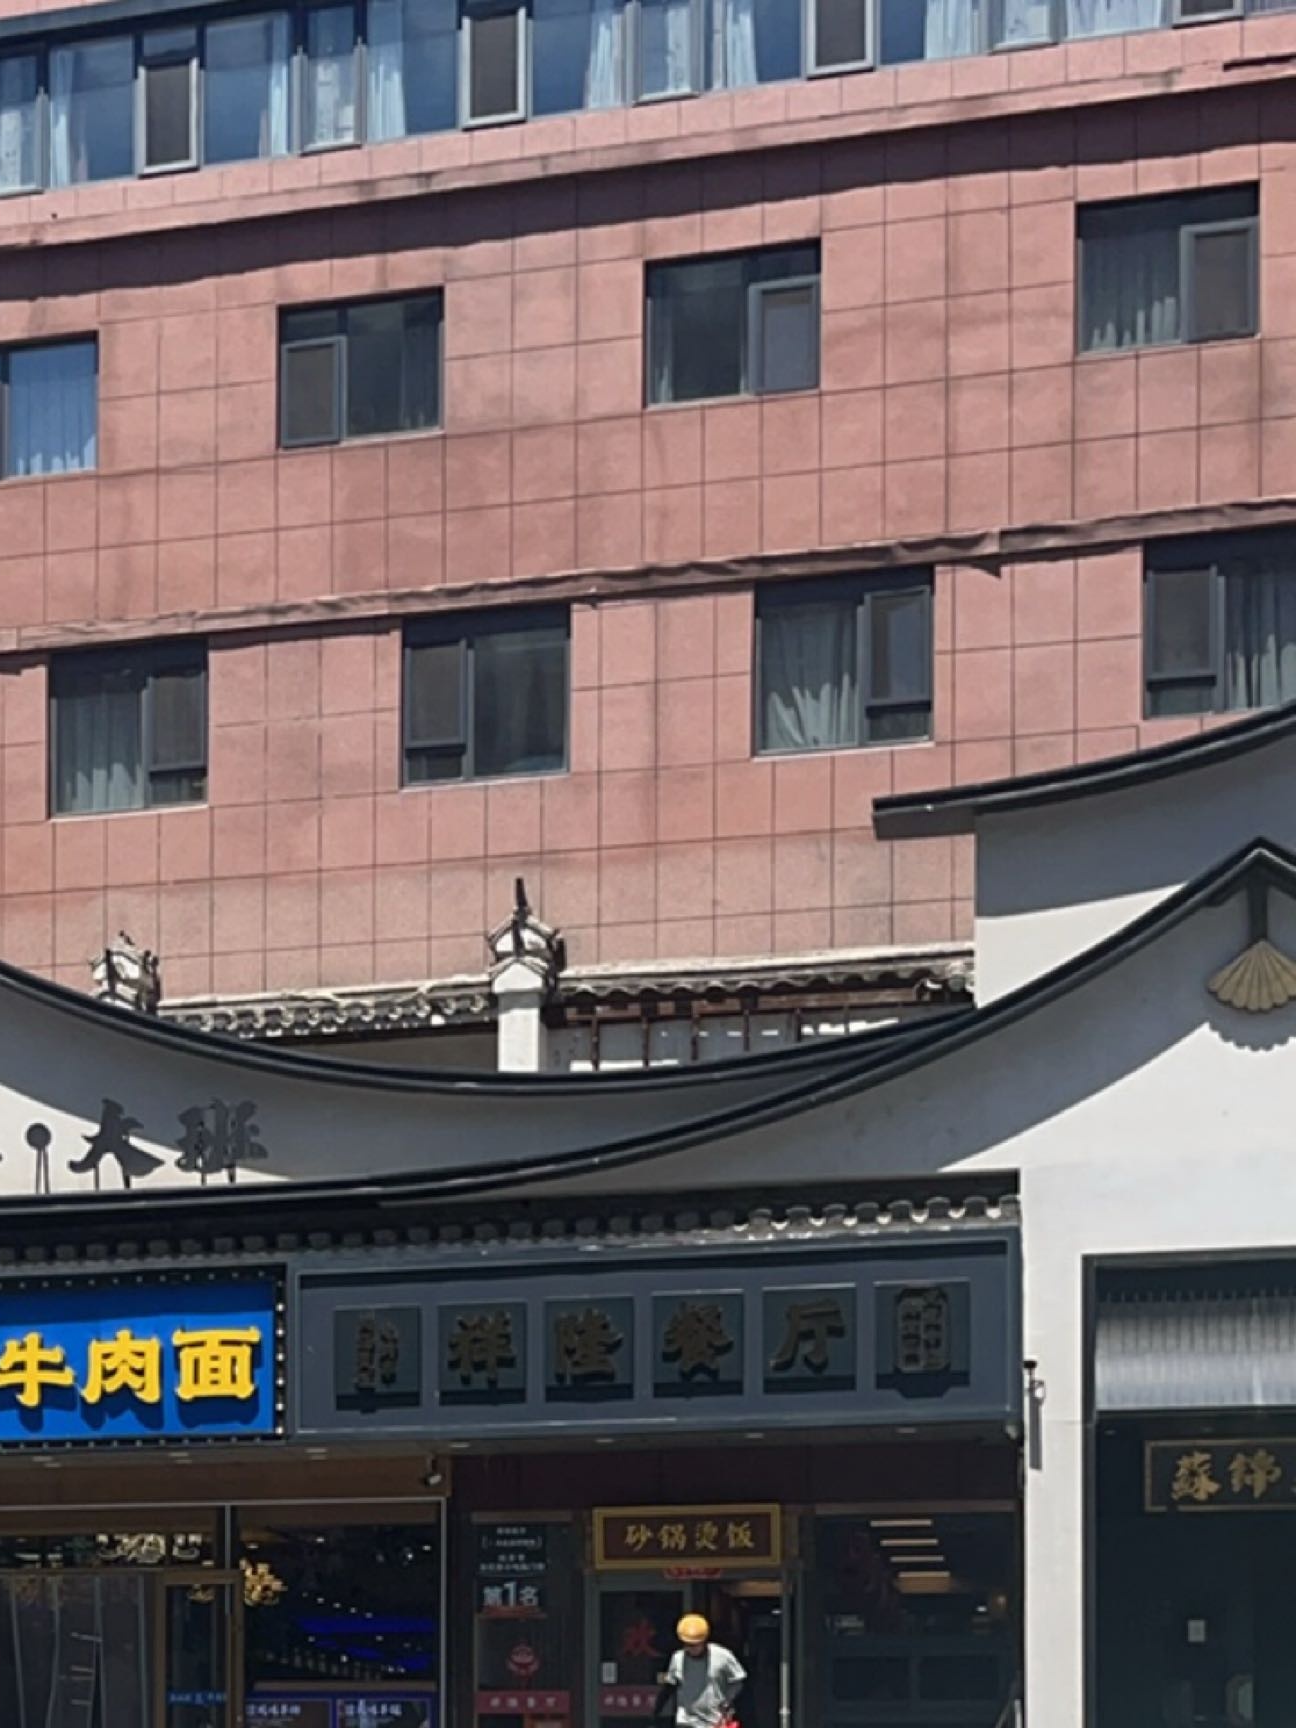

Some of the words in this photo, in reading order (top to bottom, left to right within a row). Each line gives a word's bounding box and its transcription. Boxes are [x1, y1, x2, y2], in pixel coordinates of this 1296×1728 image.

[449, 1302, 845, 1385] 祥隆餐厅
[624, 1521, 756, 1552] 砂锅烫饭
[482, 1581, 541, 1607] 第1名
